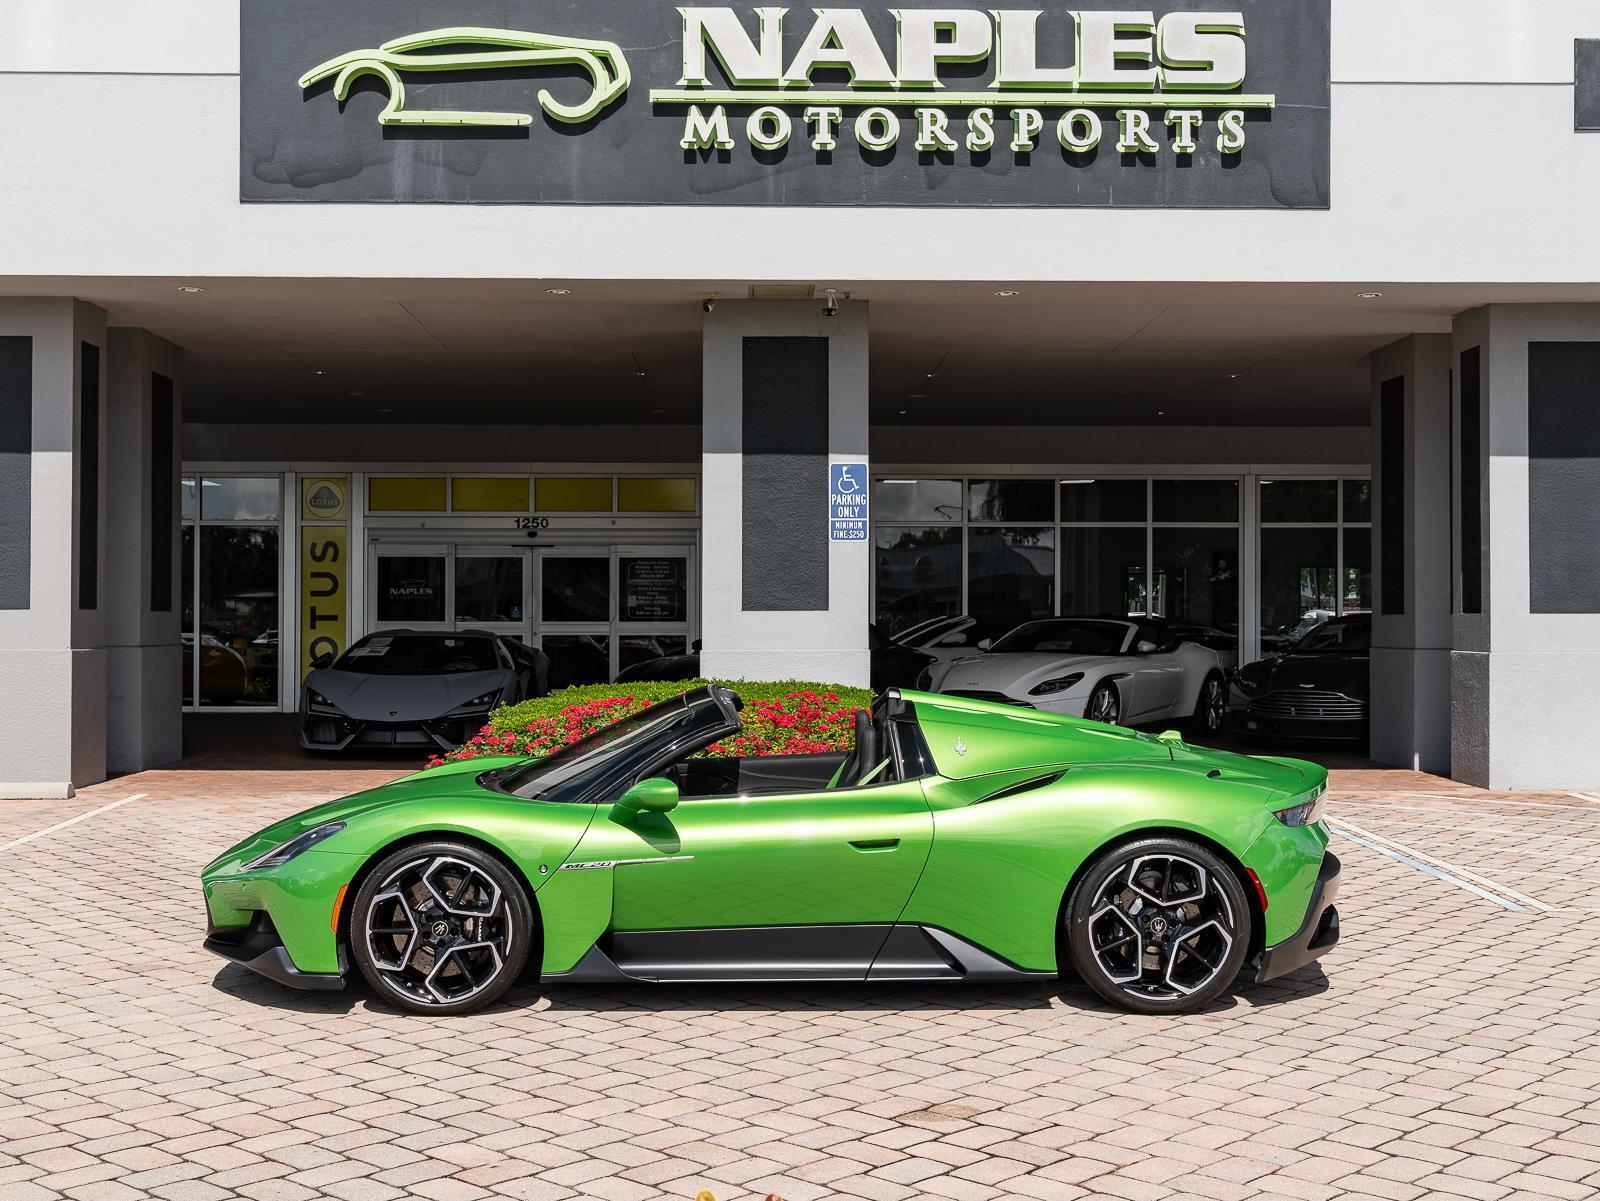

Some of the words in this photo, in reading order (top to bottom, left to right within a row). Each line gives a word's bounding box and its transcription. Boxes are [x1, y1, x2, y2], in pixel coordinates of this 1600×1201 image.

[676, 7, 1246, 90] NAPLES
[680, 105, 1246, 153] MOTORSPORTS
[831, 494, 866, 505] PARKING
[838, 506, 860, 517] ONLY
[514, 517, 549, 529] 1250
[835, 521, 863, 529] MINIMUM
[389, 587, 433, 595] NAPLES
[310, 540, 339, 663] OTUS
